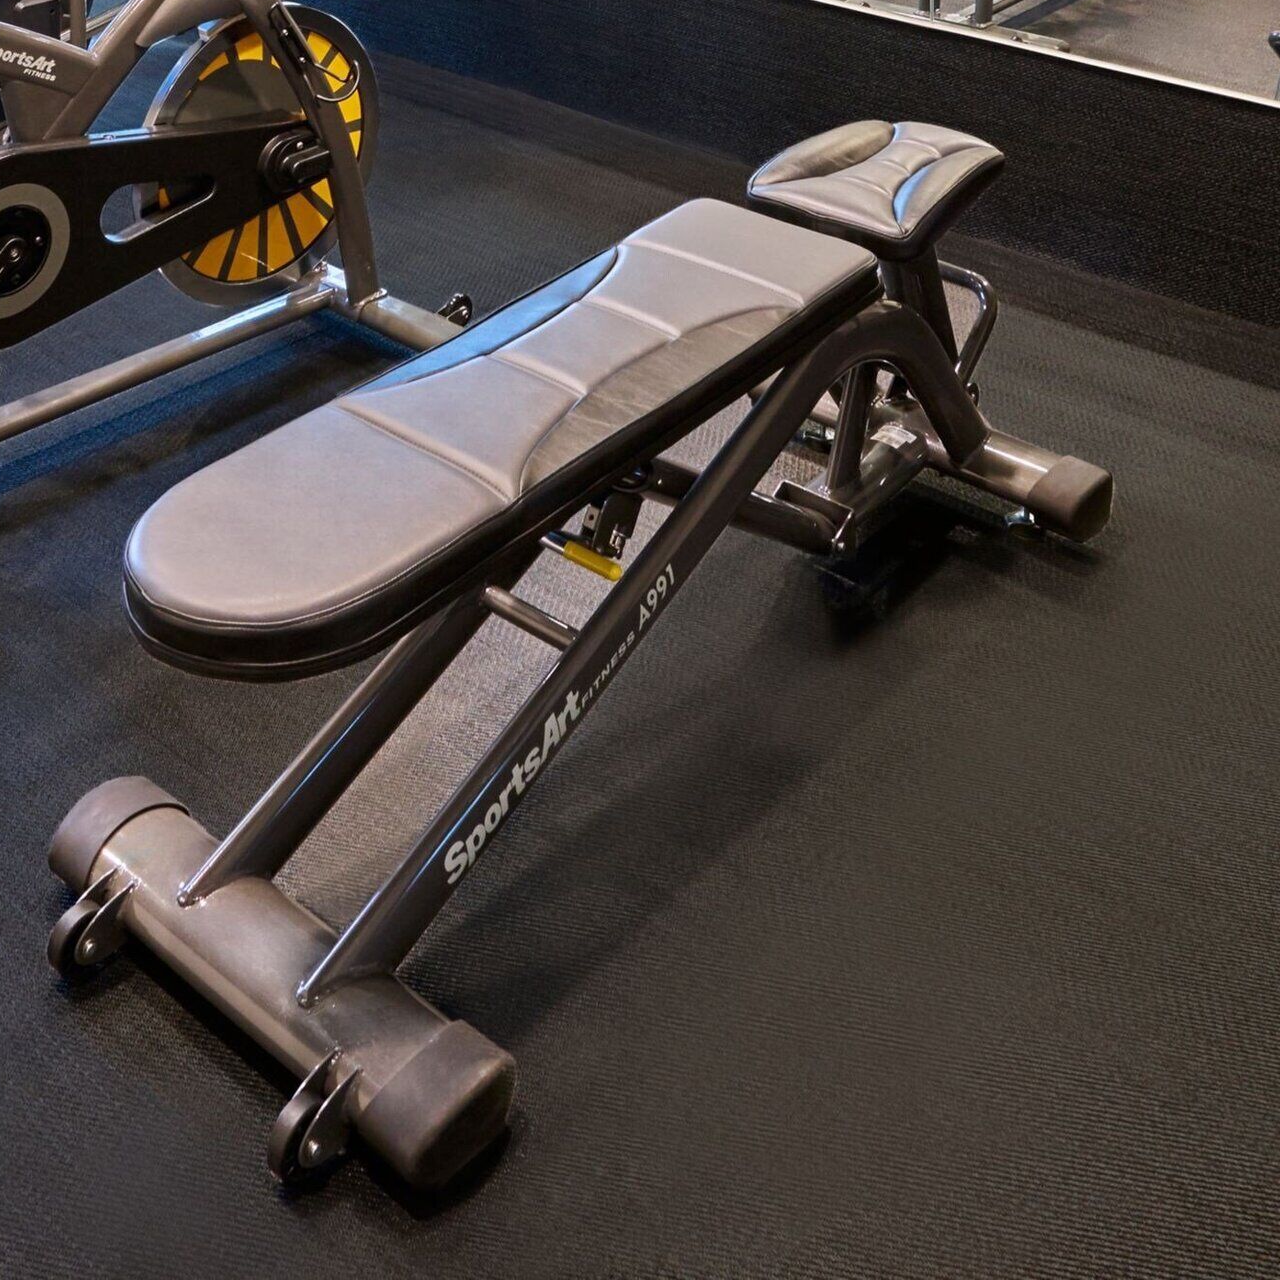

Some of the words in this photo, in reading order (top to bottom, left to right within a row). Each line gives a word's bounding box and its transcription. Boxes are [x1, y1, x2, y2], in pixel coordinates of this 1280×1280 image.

[23, 68, 56, 82] FITNESS
[443, 690, 583, 885] SportsArt
[581, 631, 636, 730] FITNESS
[637, 562, 677, 634] A991
